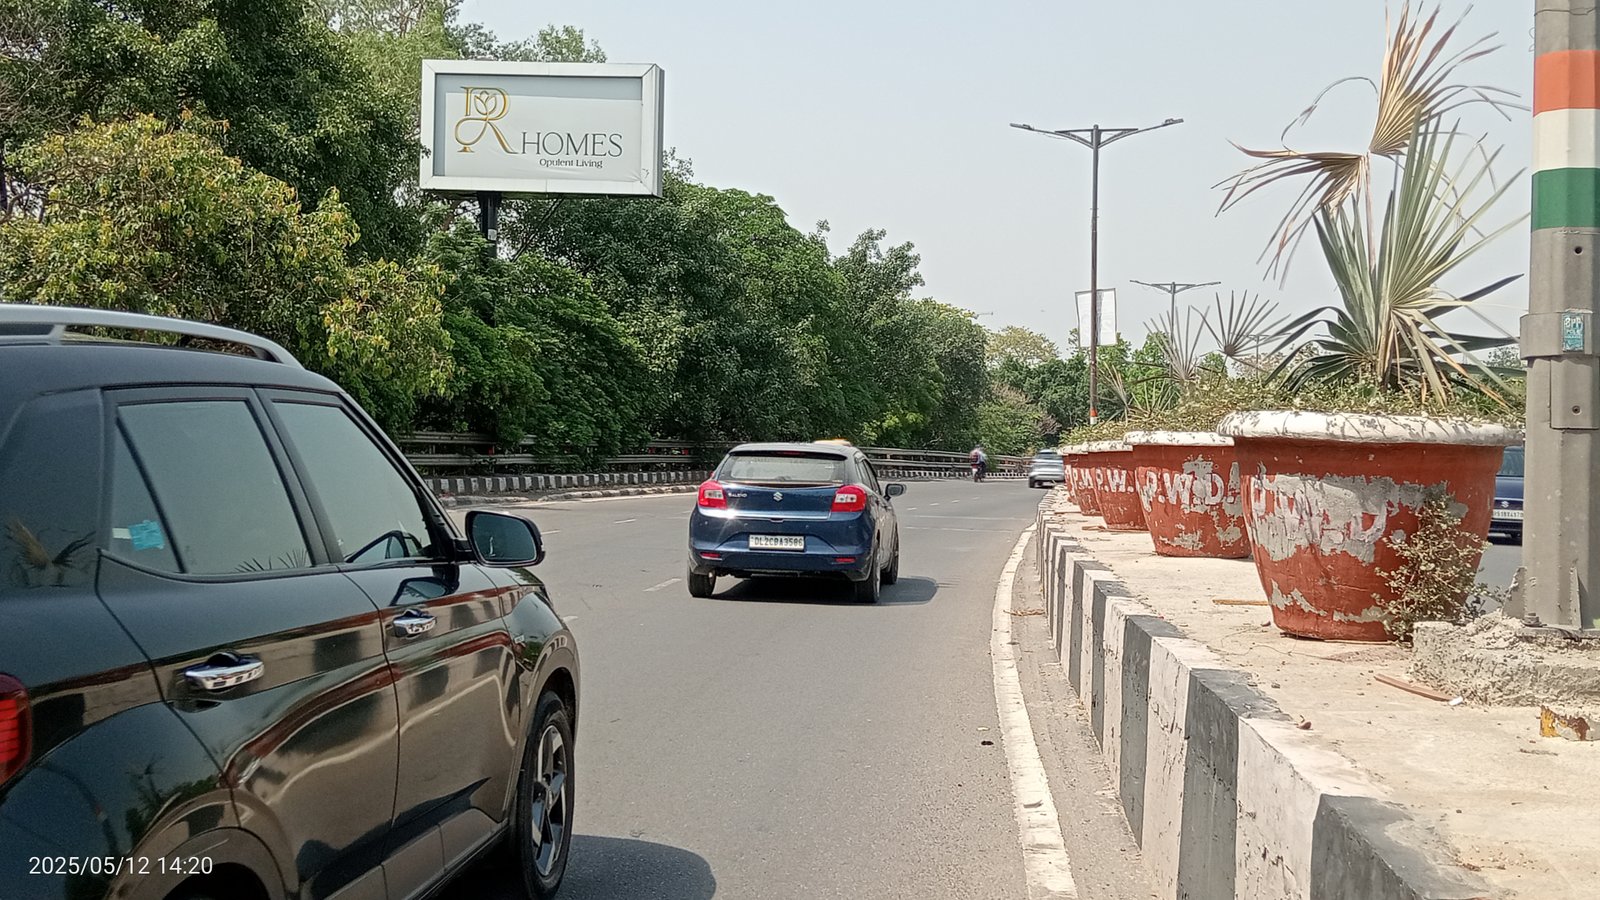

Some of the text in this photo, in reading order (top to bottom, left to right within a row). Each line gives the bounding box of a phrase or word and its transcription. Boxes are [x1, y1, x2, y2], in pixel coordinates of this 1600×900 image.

[521, 131, 623, 158] HOMES
[539, 158, 603, 169] Opulent Living
